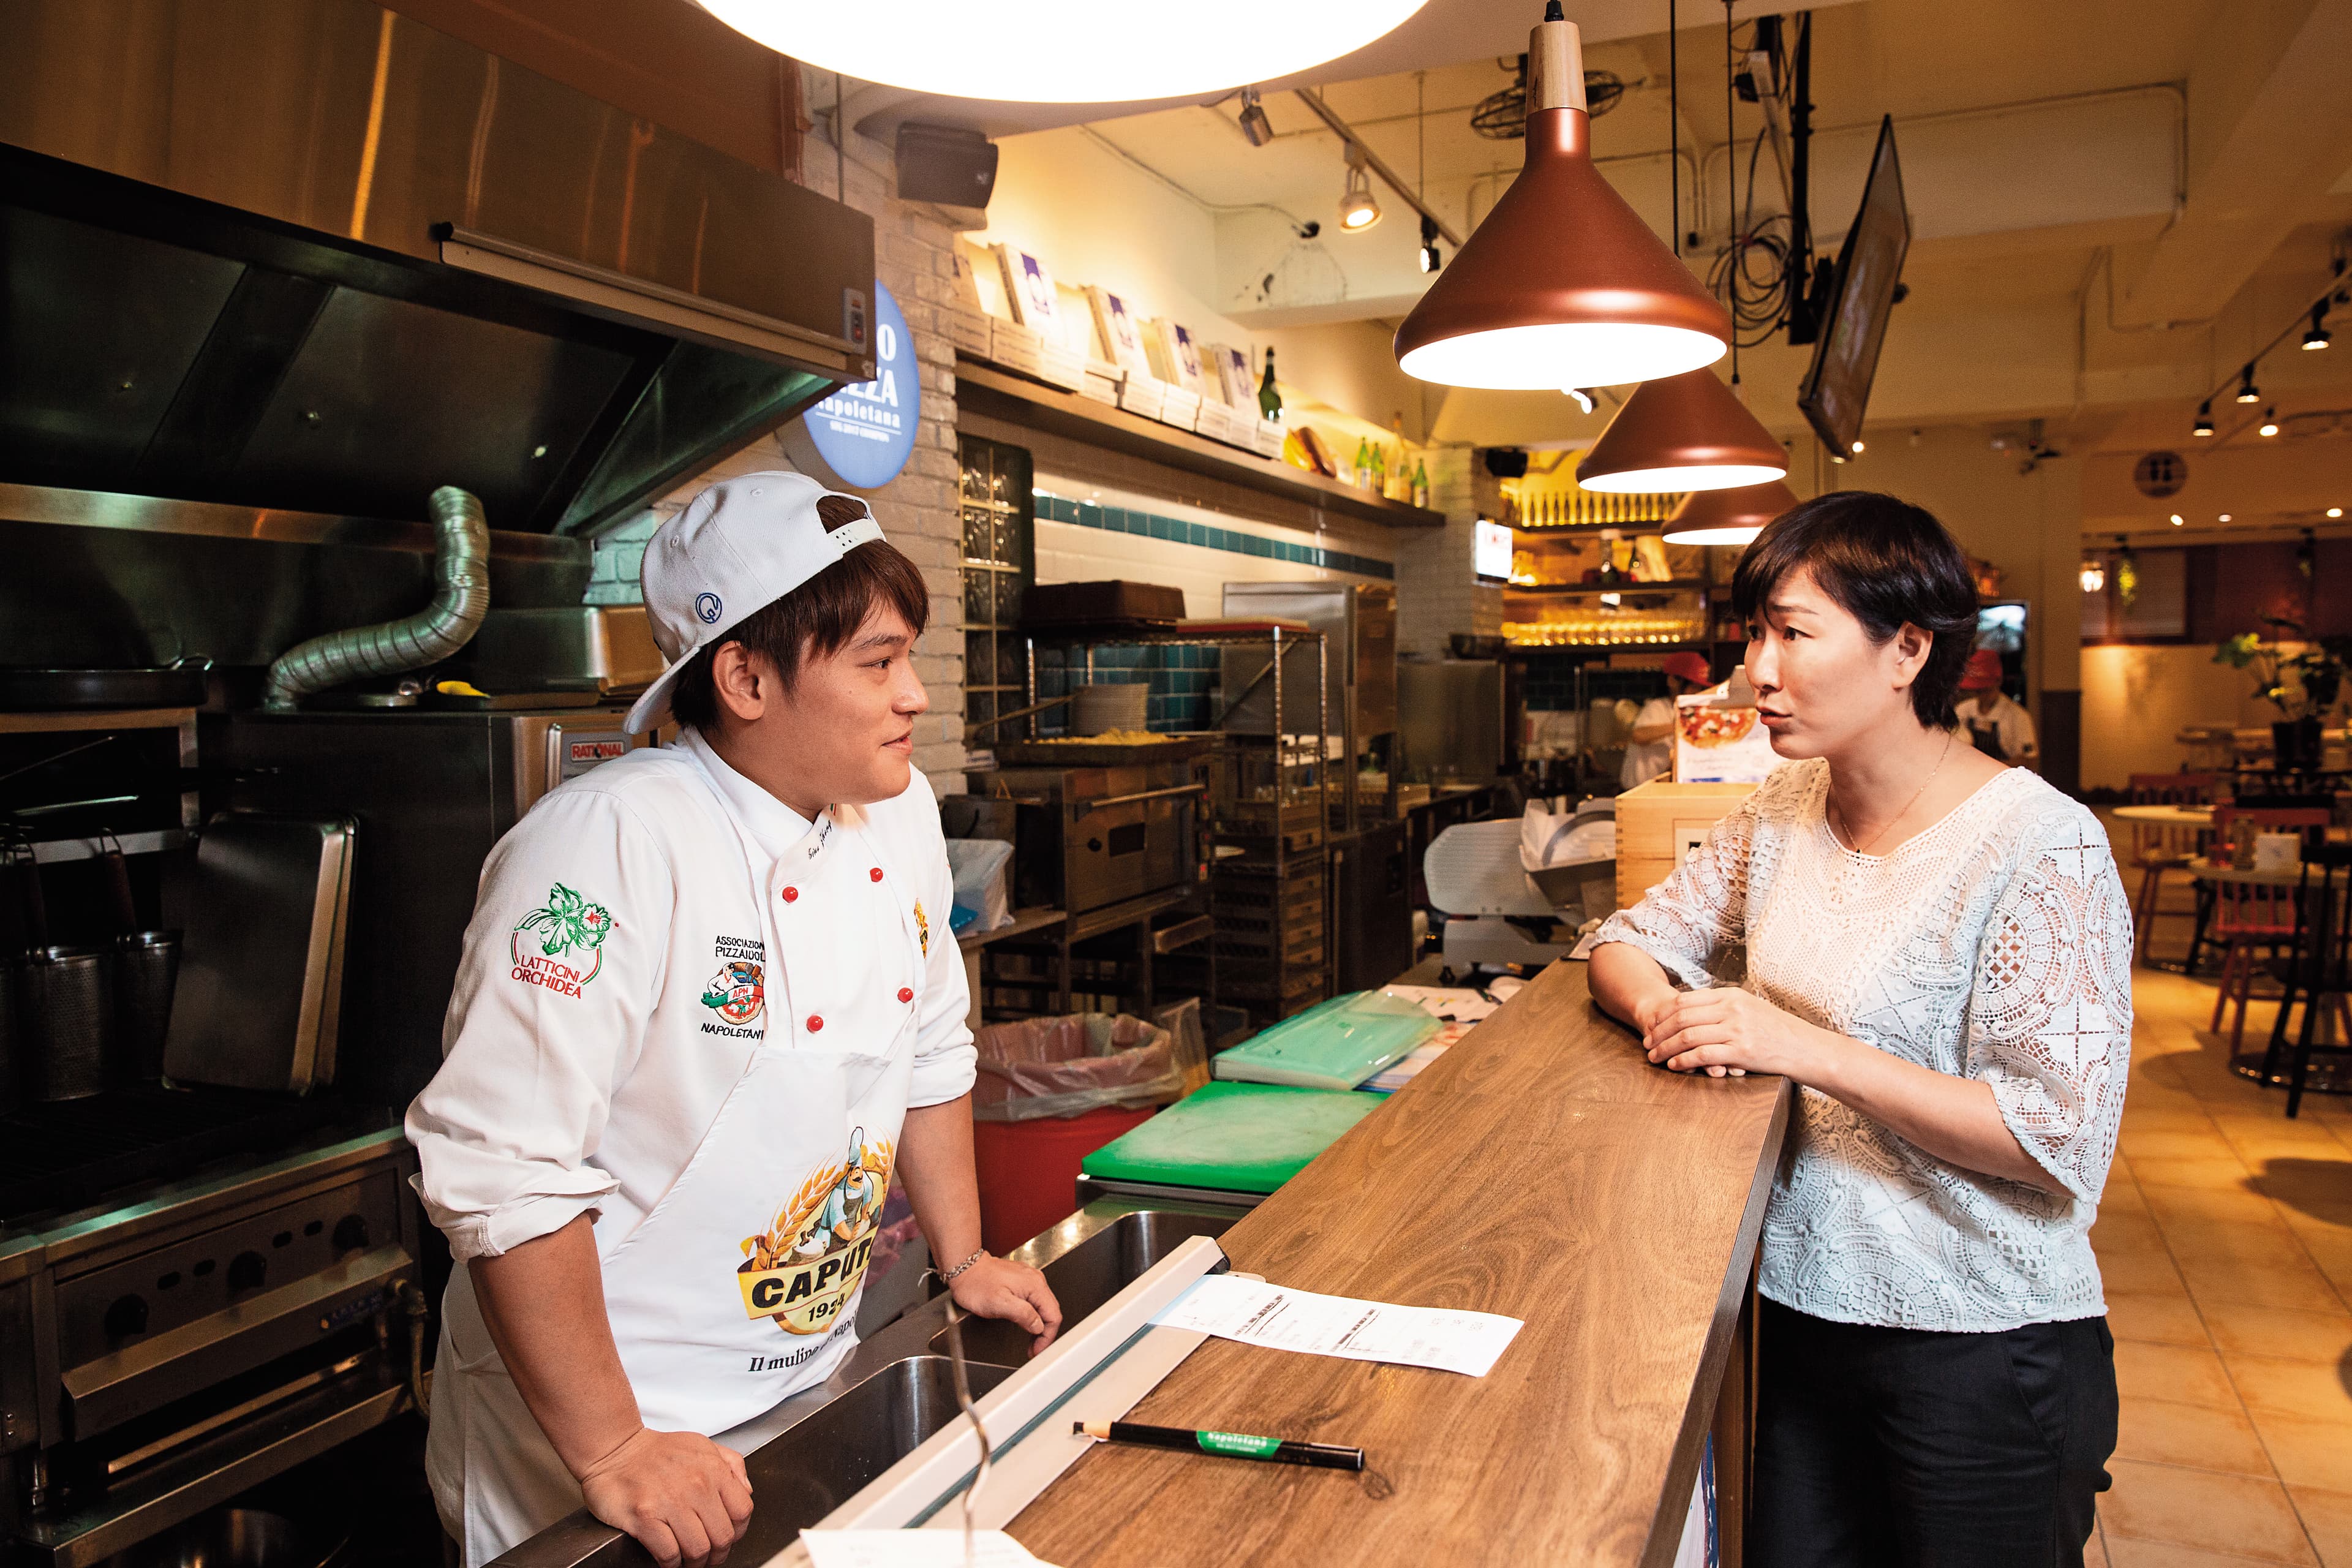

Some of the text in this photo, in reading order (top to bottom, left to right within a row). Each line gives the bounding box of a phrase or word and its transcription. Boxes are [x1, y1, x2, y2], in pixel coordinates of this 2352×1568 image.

[571, 743, 624, 758] RATIONAL
[521, 954, 580, 983] LATTICINI
[511, 967, 581, 999] ORCHIDEA
[732, 987, 748, 999] APN
[701, 1022, 764, 1040] NAPOLETANI
[752, 1236, 872, 1309] CAPUT
[767, 1346, 819, 1370] mulino
